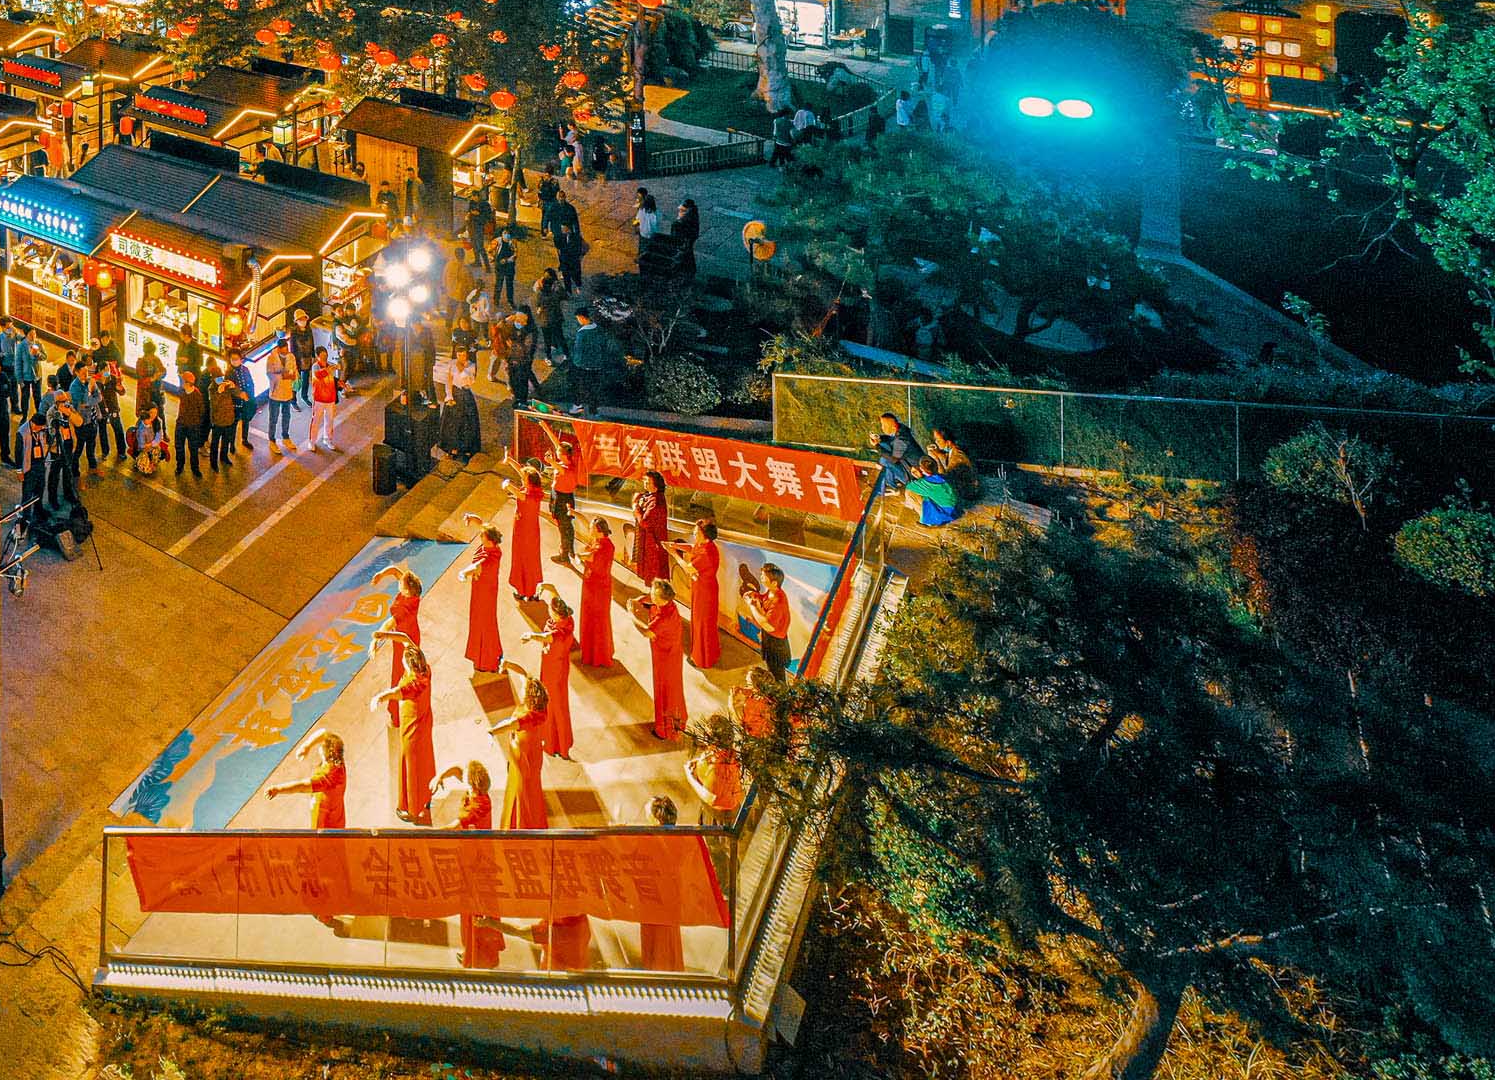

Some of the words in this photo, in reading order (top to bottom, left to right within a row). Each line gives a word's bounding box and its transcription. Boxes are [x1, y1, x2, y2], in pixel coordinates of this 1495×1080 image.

[128, 329, 170, 358] 司家
[592, 432, 842, 510] 音舞联盟大舞台
